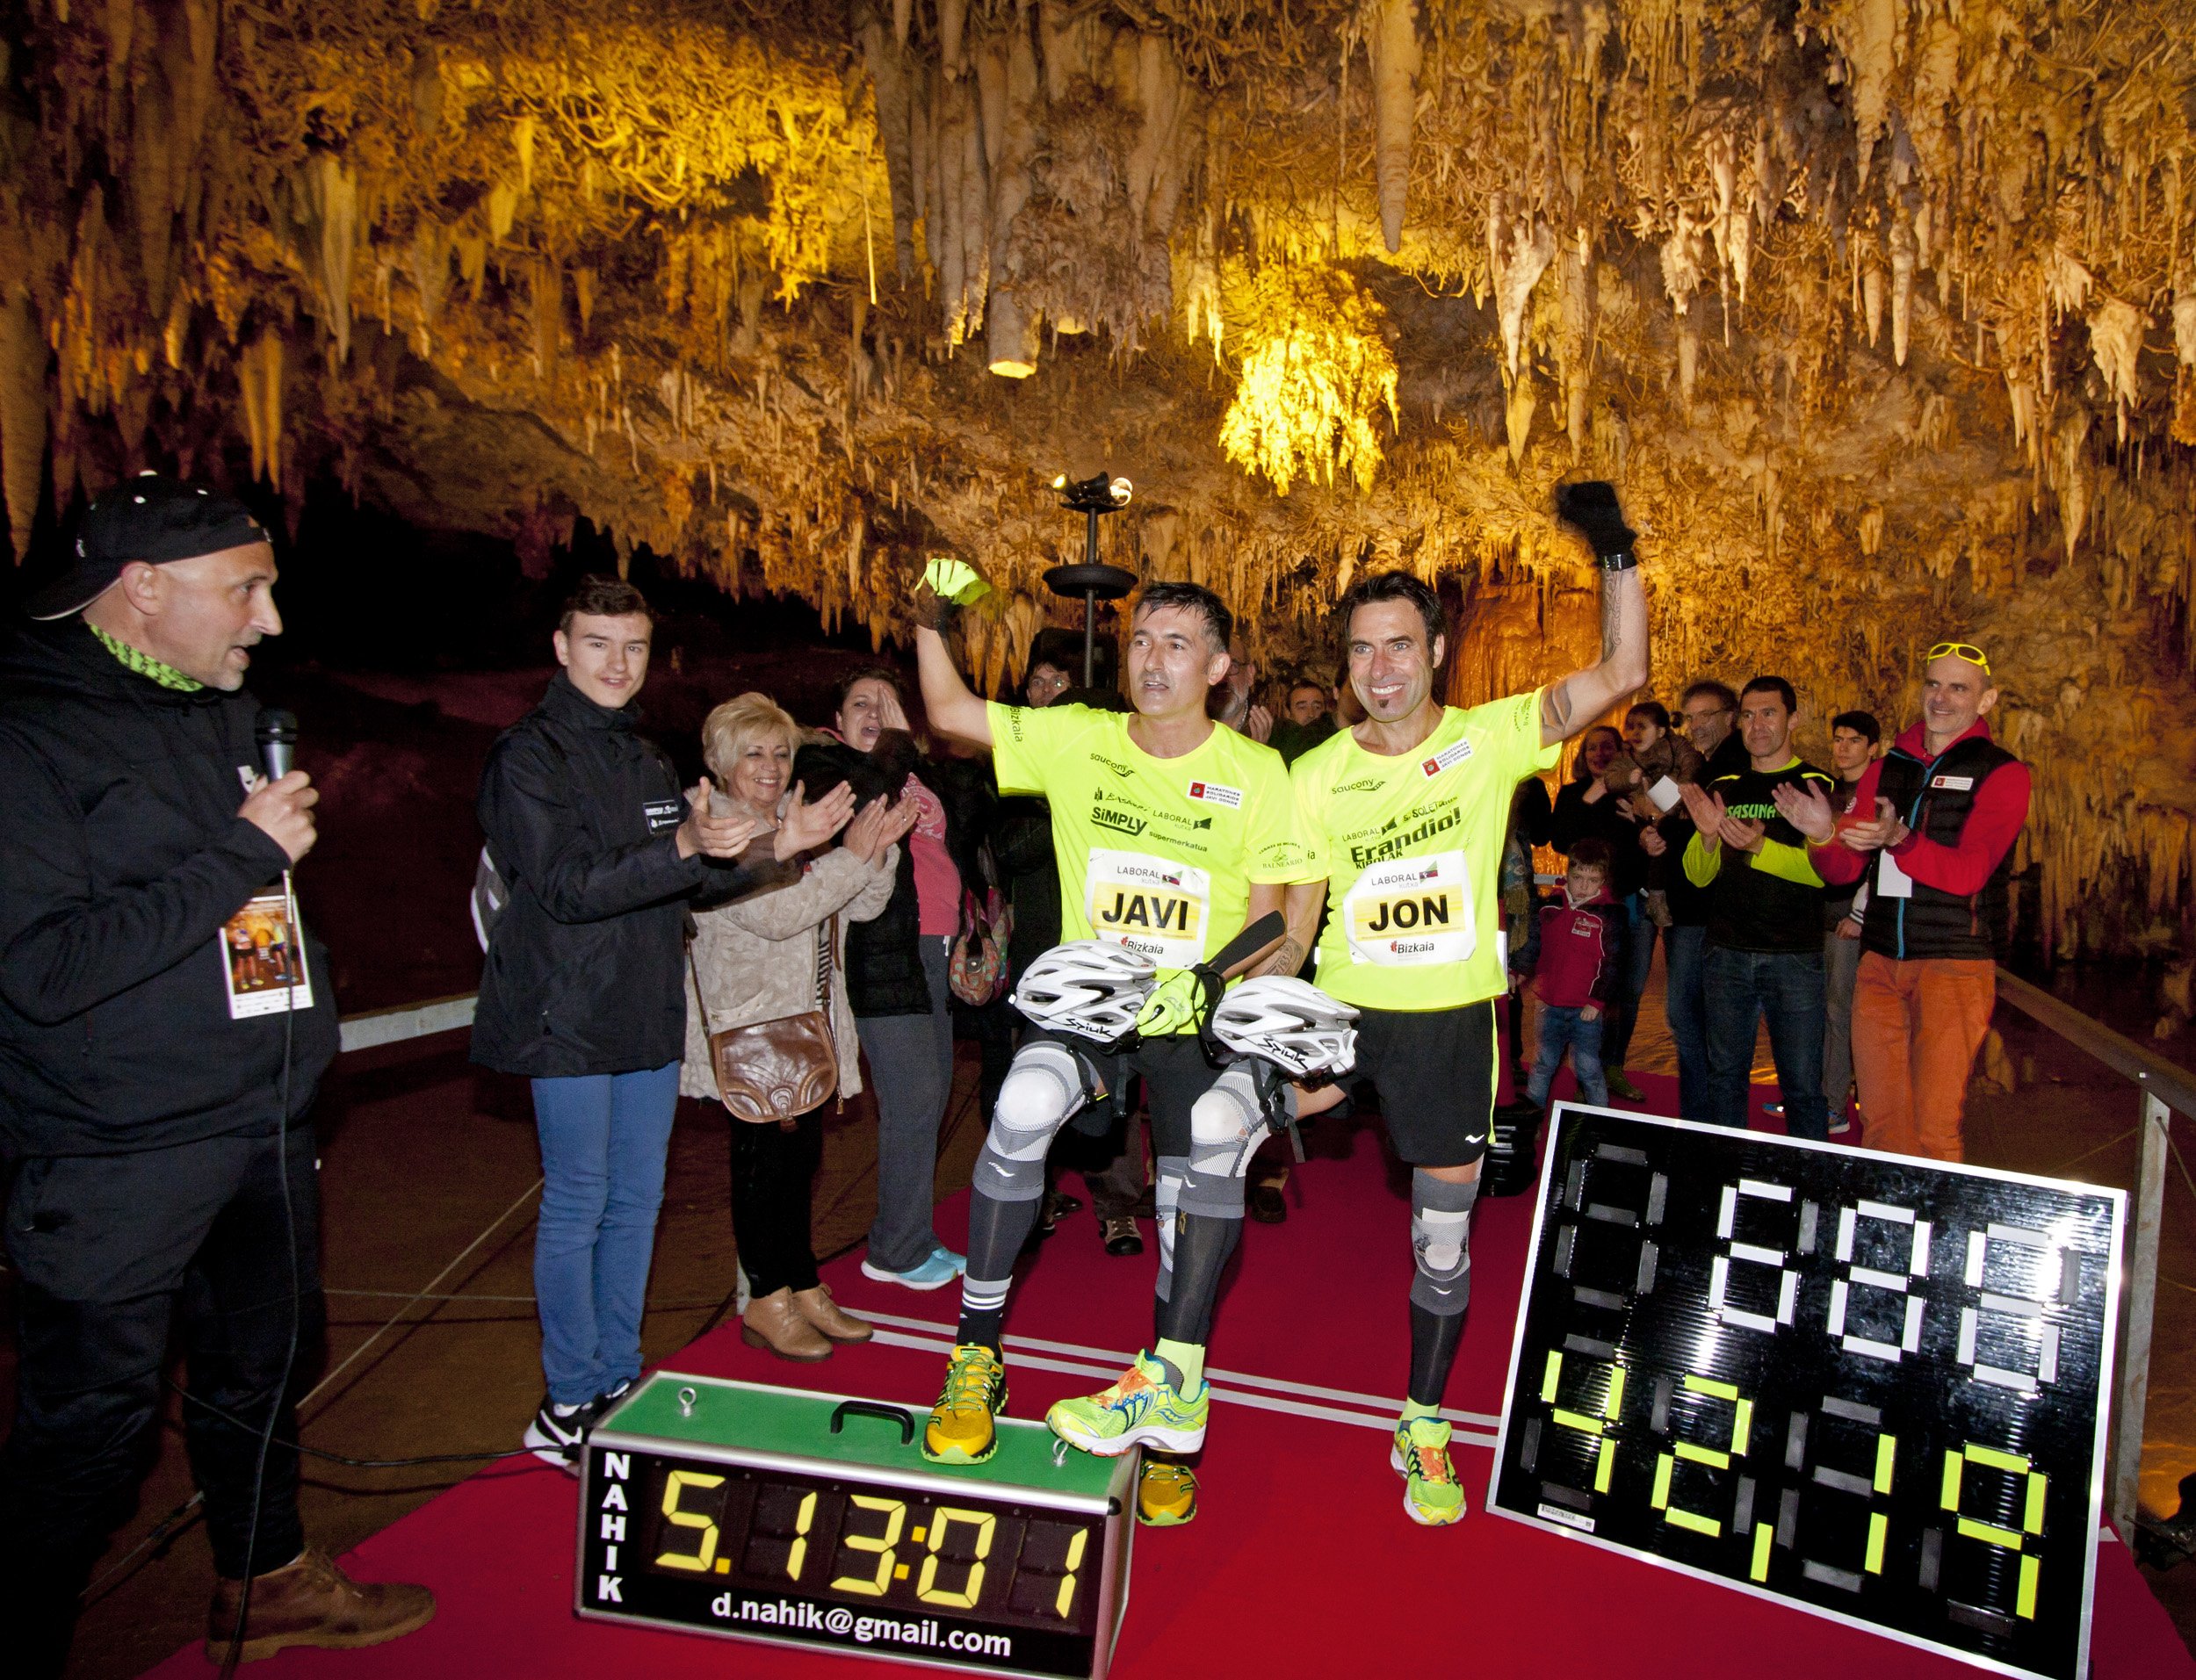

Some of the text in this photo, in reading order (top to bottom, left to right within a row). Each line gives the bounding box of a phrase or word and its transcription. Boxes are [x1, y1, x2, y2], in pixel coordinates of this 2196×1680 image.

[1010, 707, 1023, 742] Bizkaia
[1090, 753, 1129, 772] saucony
[1332, 778, 1375, 795] saucony
[1152, 810, 1193, 826] LABORAL
[1725, 804, 1776, 819] SASUNA
[1149, 831, 1208, 853] supermerkatua
[1342, 828, 1380, 842] LABORAL
[1350, 807, 1462, 863] Erandio!
[1262, 858, 1303, 869] BALNEARIO
[1116, 866, 1160, 879] LABORAL
[1371, 873, 1417, 886] LABORAL
[1102, 892, 1188, 931] JAVI
[1369, 894, 1449, 932] JON
[1127, 941, 1164, 955] Bizkaia
[1398, 941, 1435, 954] Bizkaia
[598, 1452, 630, 1604] NAHIK
[712, 1593, 1012, 1657] d.nahik@gmail.com
